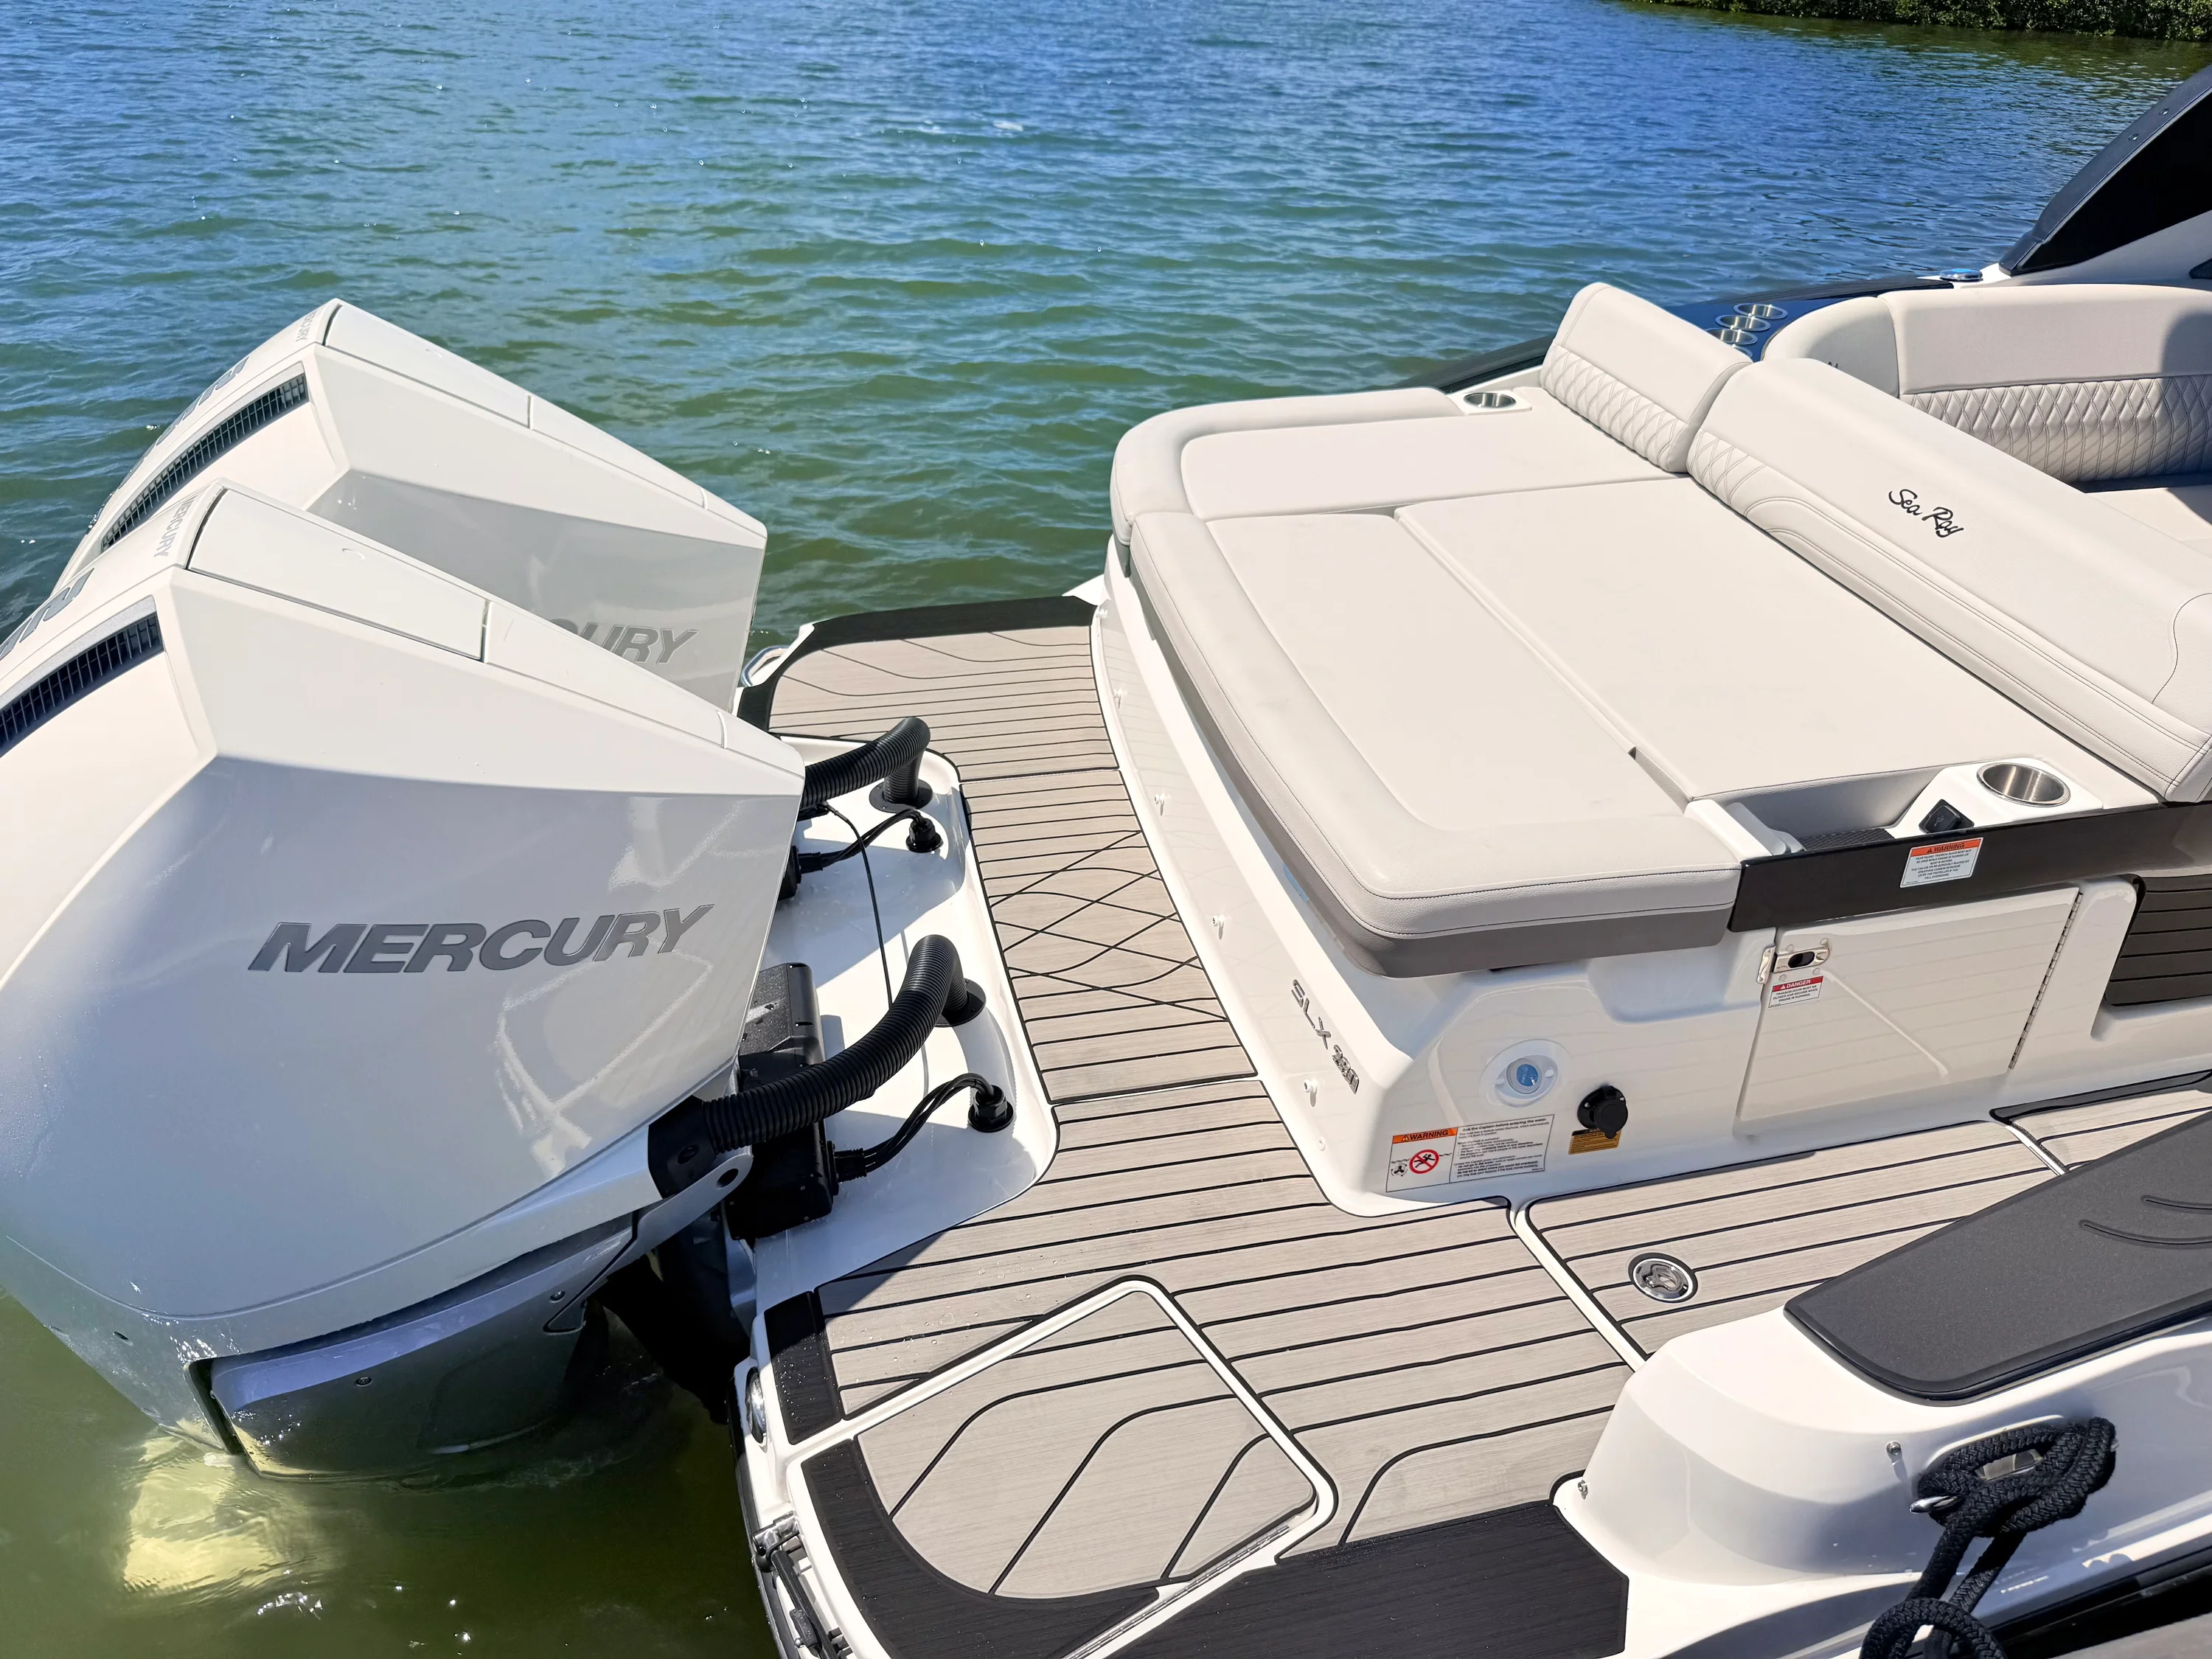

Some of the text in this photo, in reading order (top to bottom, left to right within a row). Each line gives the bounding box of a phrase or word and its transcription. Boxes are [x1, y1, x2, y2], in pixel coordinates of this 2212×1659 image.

[153, 494, 198, 557] MERCURY
[1888, 488, 1964, 538] Sea Ray
[1934, 843, 1965, 852] WARNING
[248, 904, 715, 973] MERCURY
[1787, 980, 1811, 989] DANGER
[1291, 979, 1332, 1050] SLX
[1410, 1130, 1449, 1141] WARNING
